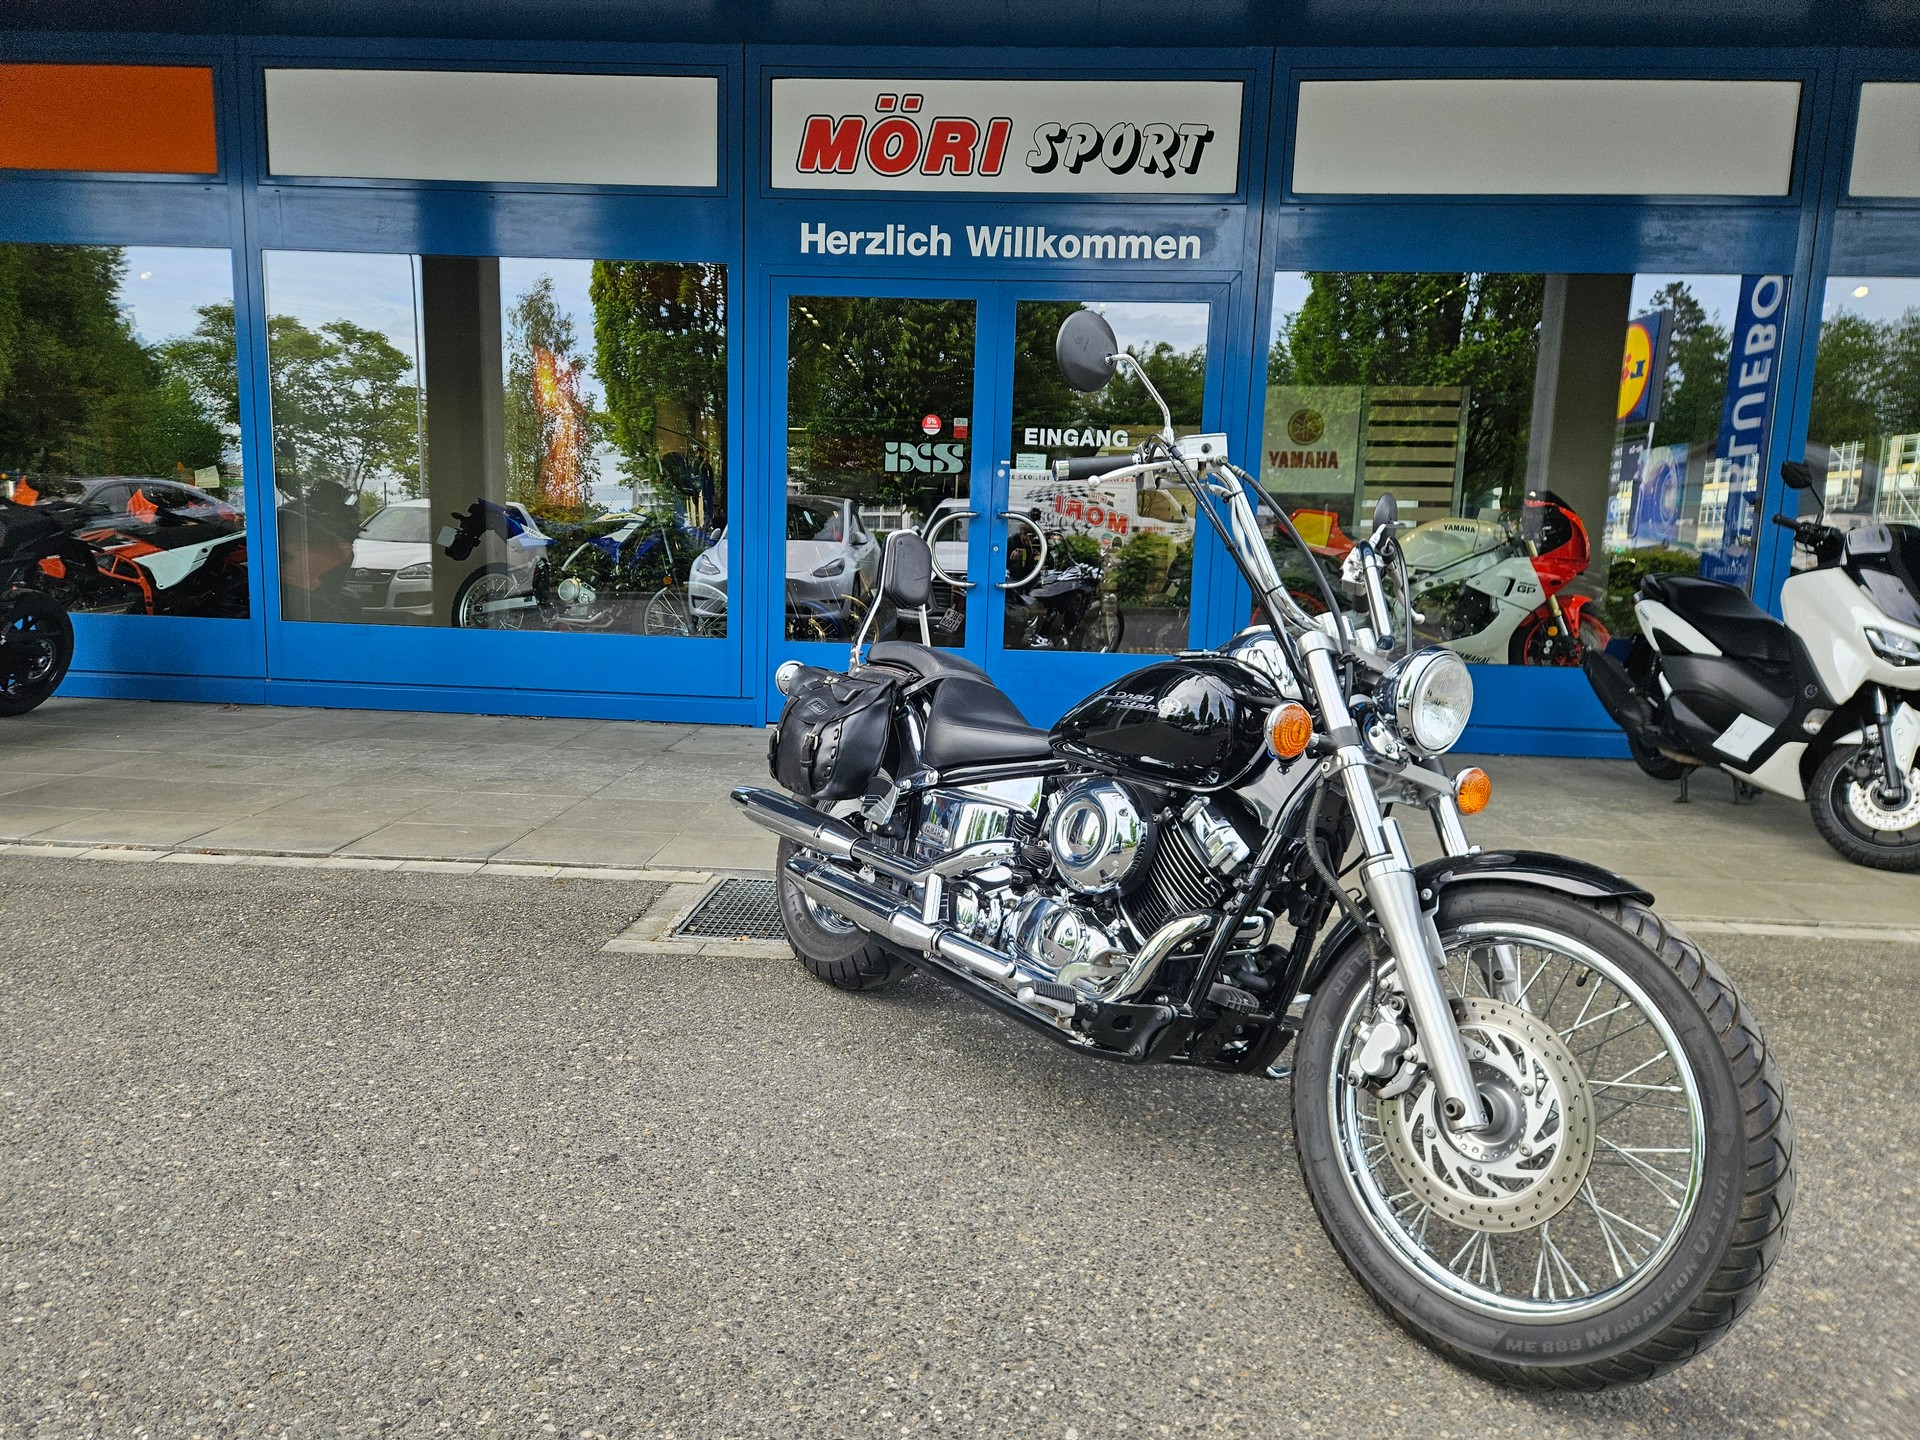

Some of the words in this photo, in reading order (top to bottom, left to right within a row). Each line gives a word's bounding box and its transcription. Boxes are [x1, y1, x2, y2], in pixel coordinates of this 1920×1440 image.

[796, 93, 1013, 176] MÖRI
[1025, 122, 1214, 178] SPORT
[800, 222, 951, 256] Herzlich
[966, 225, 1200, 259] Willkommen
[1024, 428, 1129, 447] EINGANG
[1269, 450, 1338, 469] YAMAHA
[1444, 524, 1475, 533] YAMAHA
[1517, 585, 1536, 594] GP
[1333, 946, 1370, 996] ELER
[1505, 1337, 1537, 1352] ME
